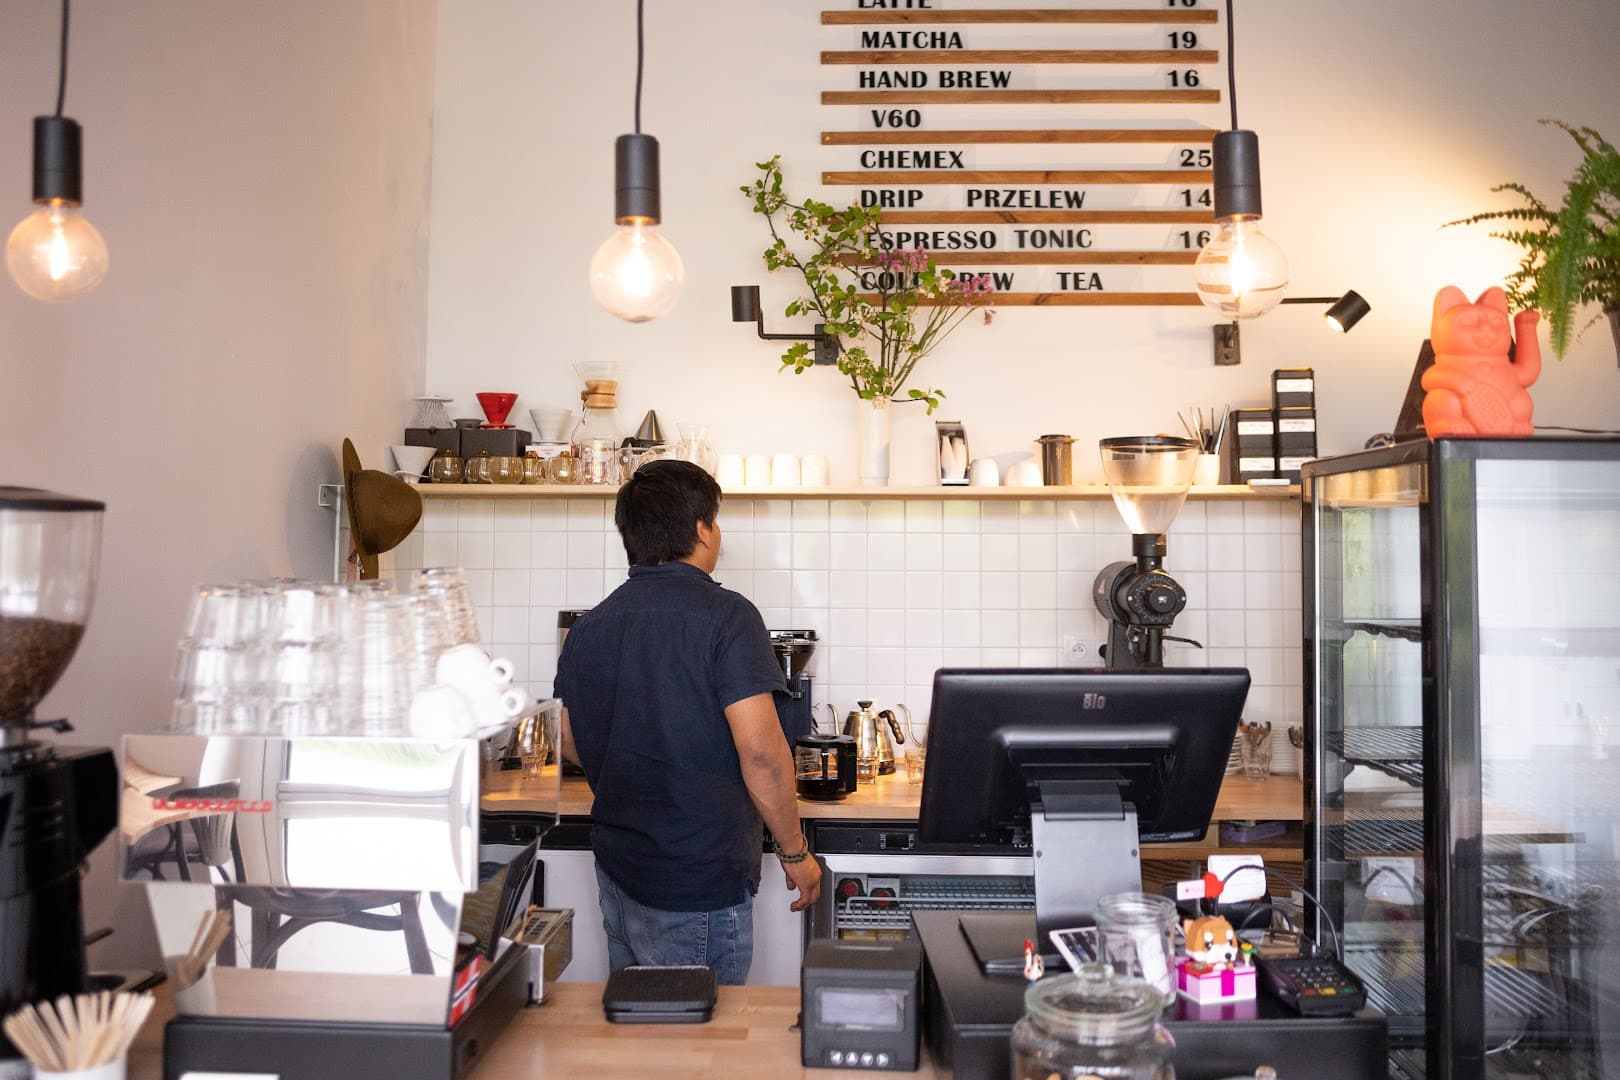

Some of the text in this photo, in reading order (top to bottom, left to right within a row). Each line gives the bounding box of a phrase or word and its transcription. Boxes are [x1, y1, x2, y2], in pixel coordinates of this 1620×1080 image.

[861, 31, 1197, 49] MATCHA 19
[859, 69, 1200, 88] HAND BREW 16
[872, 109, 921, 128] V60
[860, 149, 1212, 169] CHEMEX 25
[861, 188, 1212, 208] DRIP PRZELEW 14
[866, 229, 1211, 249] ESPRESSO TONIC 16
[948, 272, 1014, 291] RW
[1056, 272, 1104, 291] TEA
